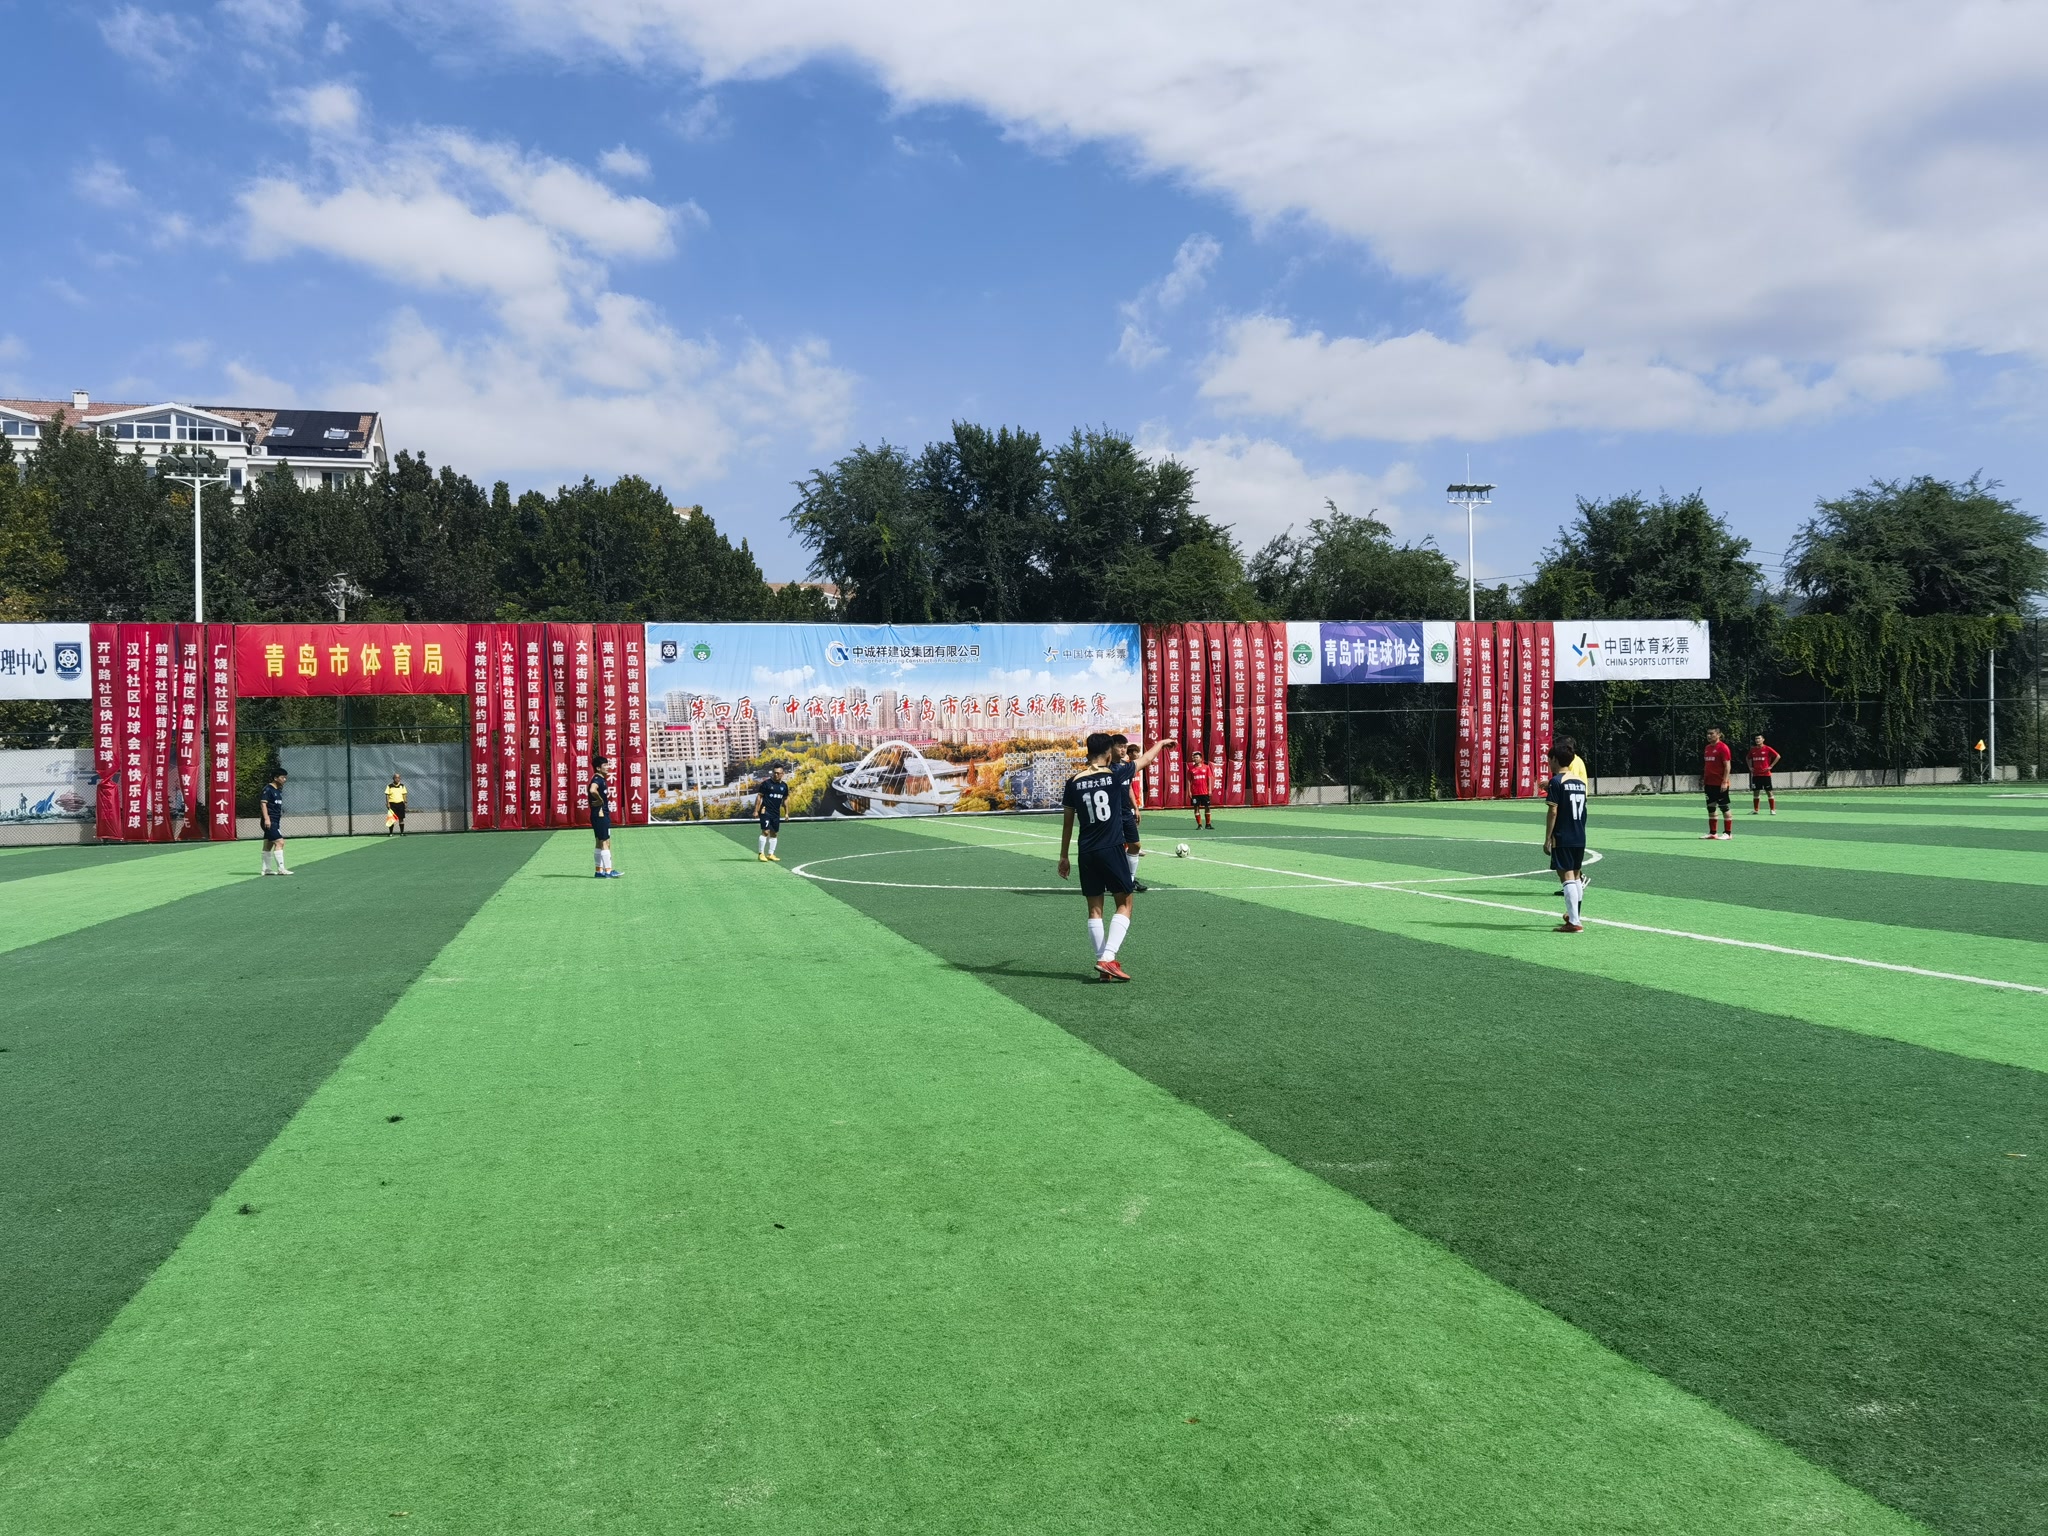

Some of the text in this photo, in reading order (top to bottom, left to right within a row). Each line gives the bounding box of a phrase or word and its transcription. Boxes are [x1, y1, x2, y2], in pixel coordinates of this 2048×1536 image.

[264, 642, 443, 677] 青岛市体育局
[852, 645, 980, 658] 中诚祥建设集团有限公司
[1062, 648, 1127, 659] 中国体育彩票
[1324, 638, 1420, 667] 青岛市足球协会
[1604, 637, 1689, 654] 中国体育彩票
[0, 648, 47, 676] 理中心
[1605, 657, 1689, 666] CHINA SPORTS LOTTERY
[602, 641, 618, 813] 莱西千禧之城无足球不兄弟
[1253, 638, 1266, 794] 东乌衣巷社区努力拼搏永不言败
[1480, 637, 1491, 789] 枯桃社区团结起来向前出发
[126, 642, 141, 829] 汉河社区以球会友快乐足球
[214, 644, 229, 826] 广饶路社区从一棵树到一个家
[1082, 790, 1111, 823] 18
[1569, 793, 1585, 821] 17
